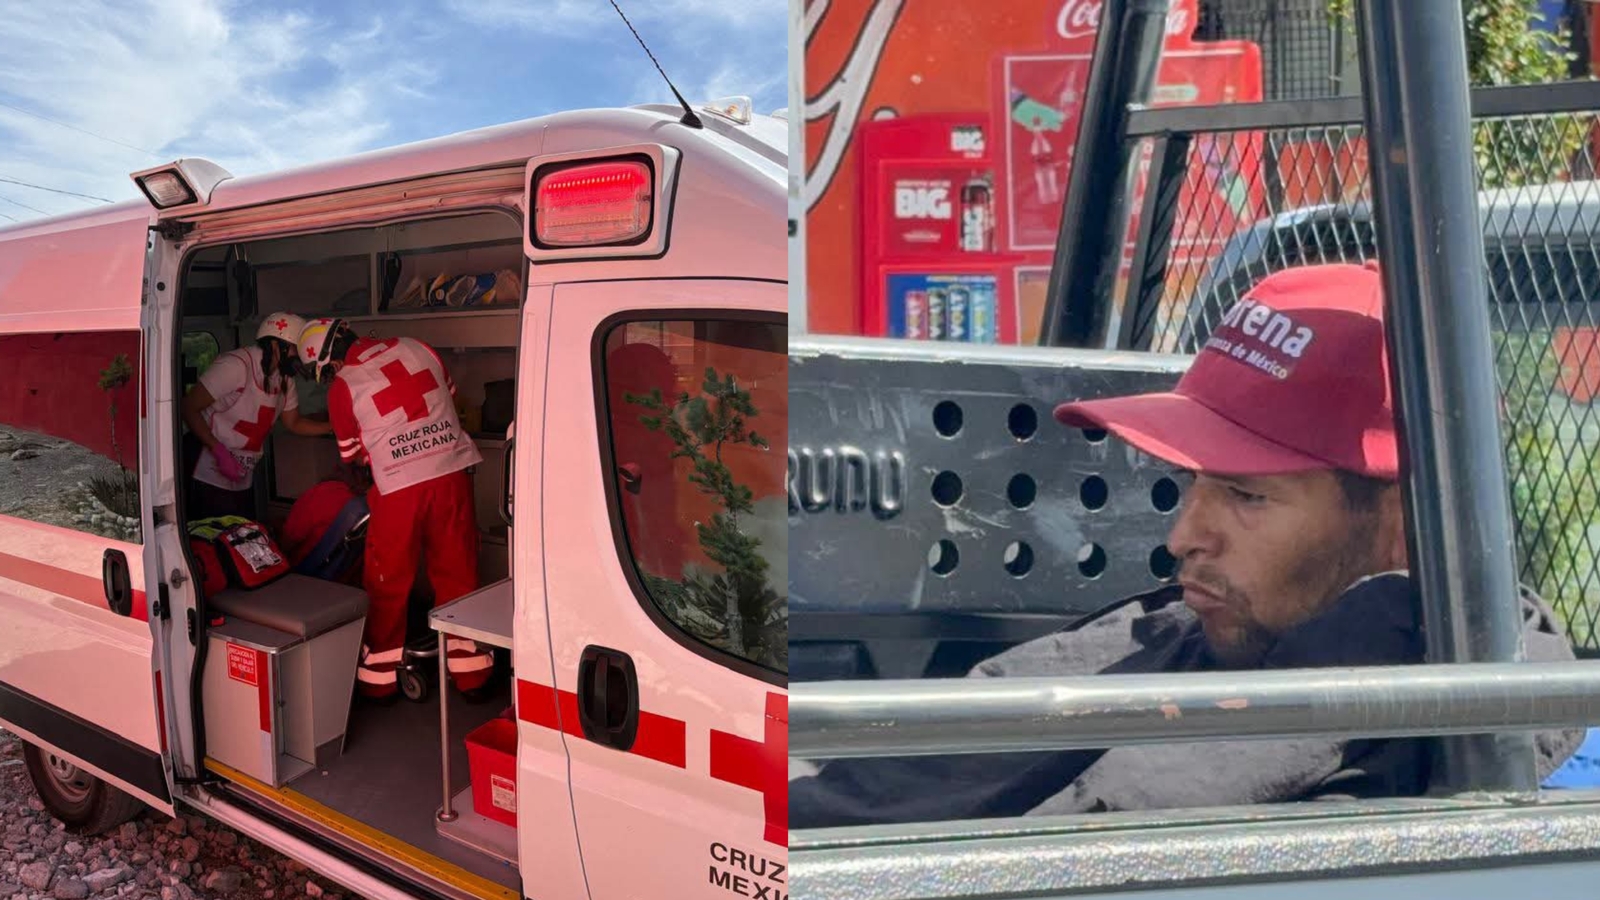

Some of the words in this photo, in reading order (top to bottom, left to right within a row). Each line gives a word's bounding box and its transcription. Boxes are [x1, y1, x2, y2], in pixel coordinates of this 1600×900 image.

[895, 187, 951, 219] BIG
[1231, 343, 1246, 359] de
[1245, 350, 1288, 379] México
[389, 429, 421, 447] CRUZ
[422, 420, 453, 437] ROJA
[391, 432, 457, 460] MEXICANA
[710, 842, 786, 885] CRUZ
[709, 865, 788, 900] MEXI
